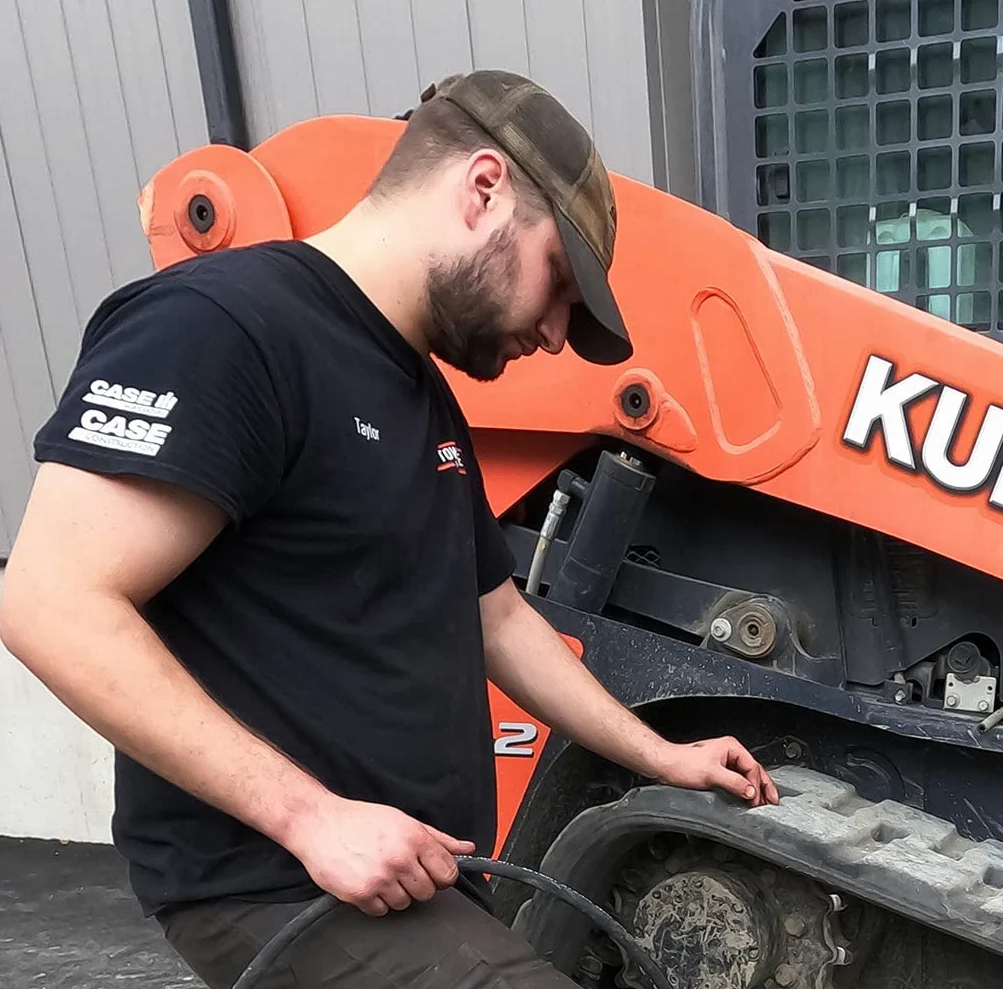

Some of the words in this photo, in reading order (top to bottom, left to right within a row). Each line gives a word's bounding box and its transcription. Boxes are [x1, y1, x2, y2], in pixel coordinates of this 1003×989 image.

[90, 379, 157, 406] CASE
[81, 409, 173, 446] CASE
[354, 416, 380, 441] Taylor
[494, 722, 538, 758] 2
